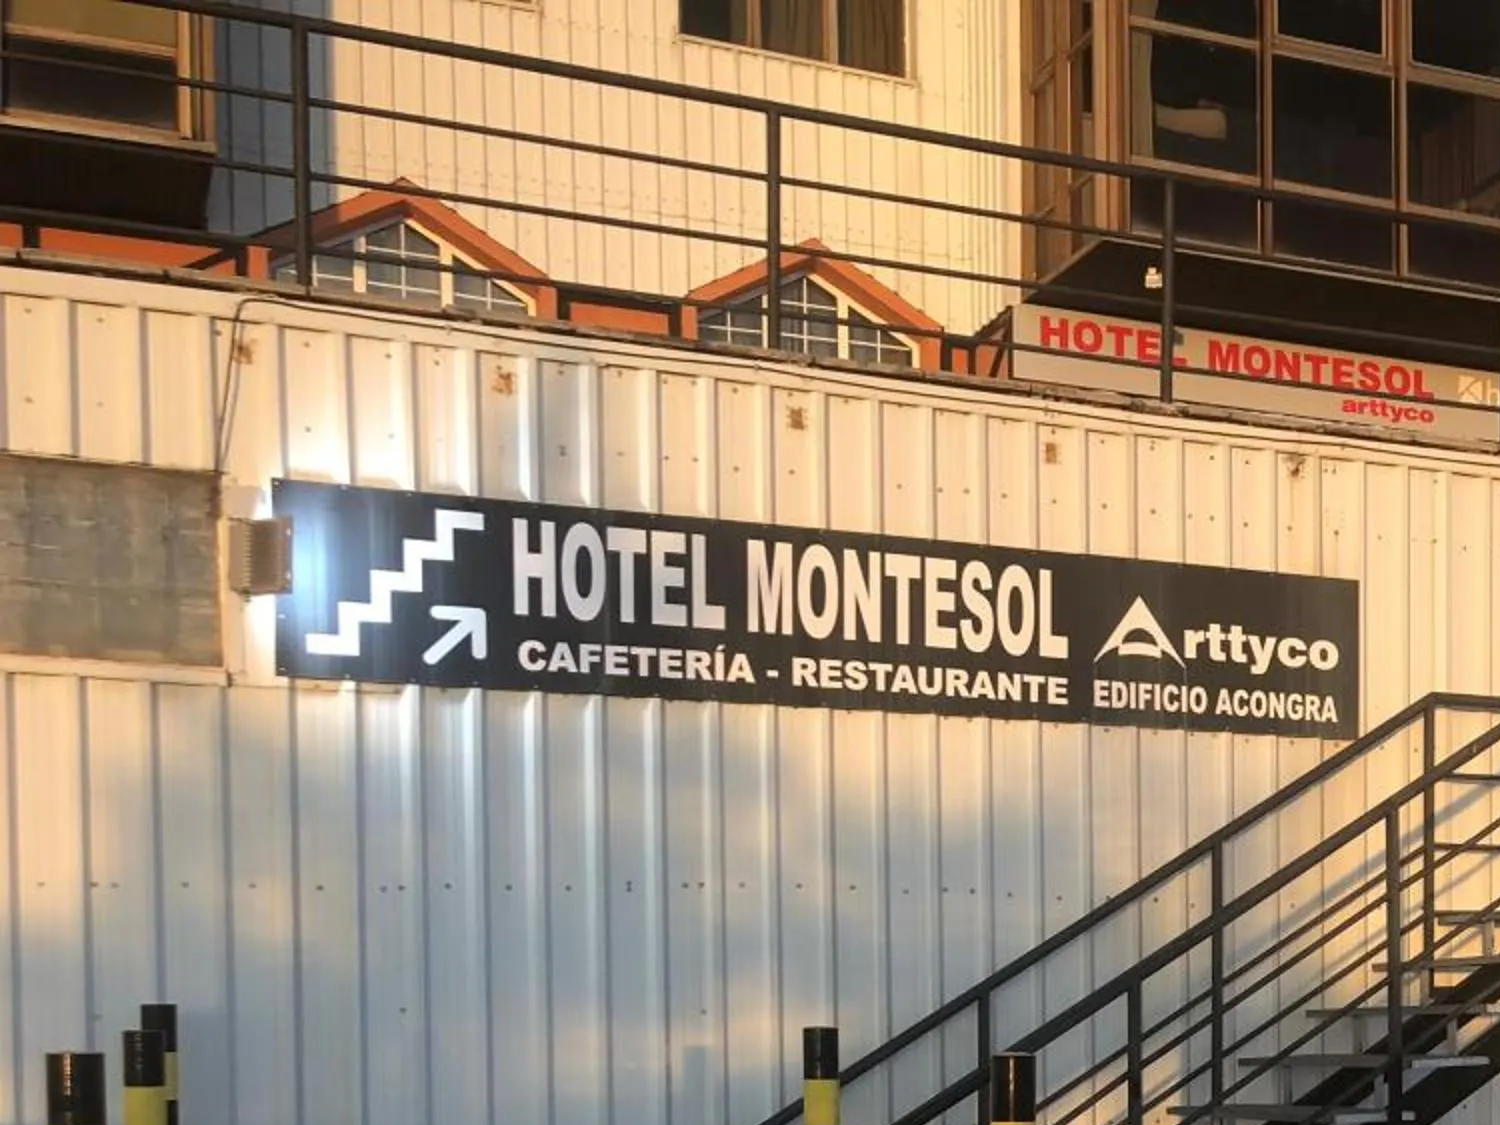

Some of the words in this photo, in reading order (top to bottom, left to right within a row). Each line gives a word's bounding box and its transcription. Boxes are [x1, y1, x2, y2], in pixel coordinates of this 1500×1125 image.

[1207, 339, 1435, 400] MONTESOL
[1341, 398, 1435, 425] arttyco
[512, 517, 726, 630] HOTEL
[747, 538, 1069, 660] MONTESOL
[1094, 595, 1340, 676] Arttyco
[517, 638, 756, 685] CAFETERÍA
[791, 656, 1070, 706] RESTAURANTE
[1093, 678, 1208, 714] EDIFICIO
[1214, 687, 1339, 723] ACONGRA
